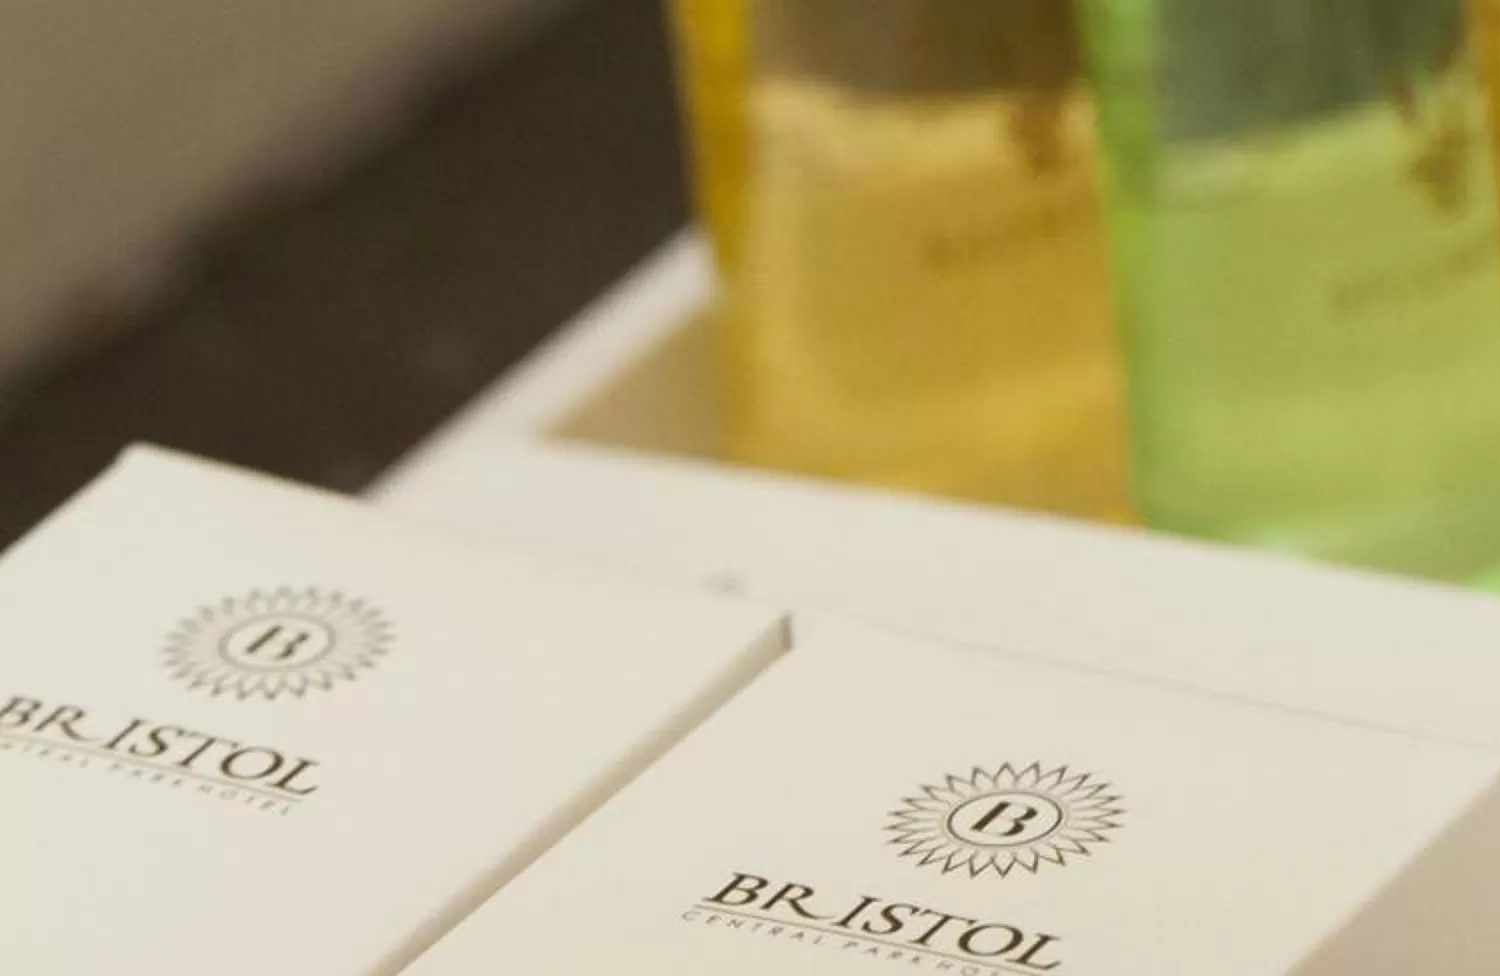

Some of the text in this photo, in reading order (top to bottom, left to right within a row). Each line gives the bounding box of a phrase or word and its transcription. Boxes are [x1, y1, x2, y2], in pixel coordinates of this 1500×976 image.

[970, 800, 1039, 838] B
[681, 910, 824, 946] CENTRAL
[843, 940, 922, 964] PARK
[701, 871, 1062, 971] BRISTOL
